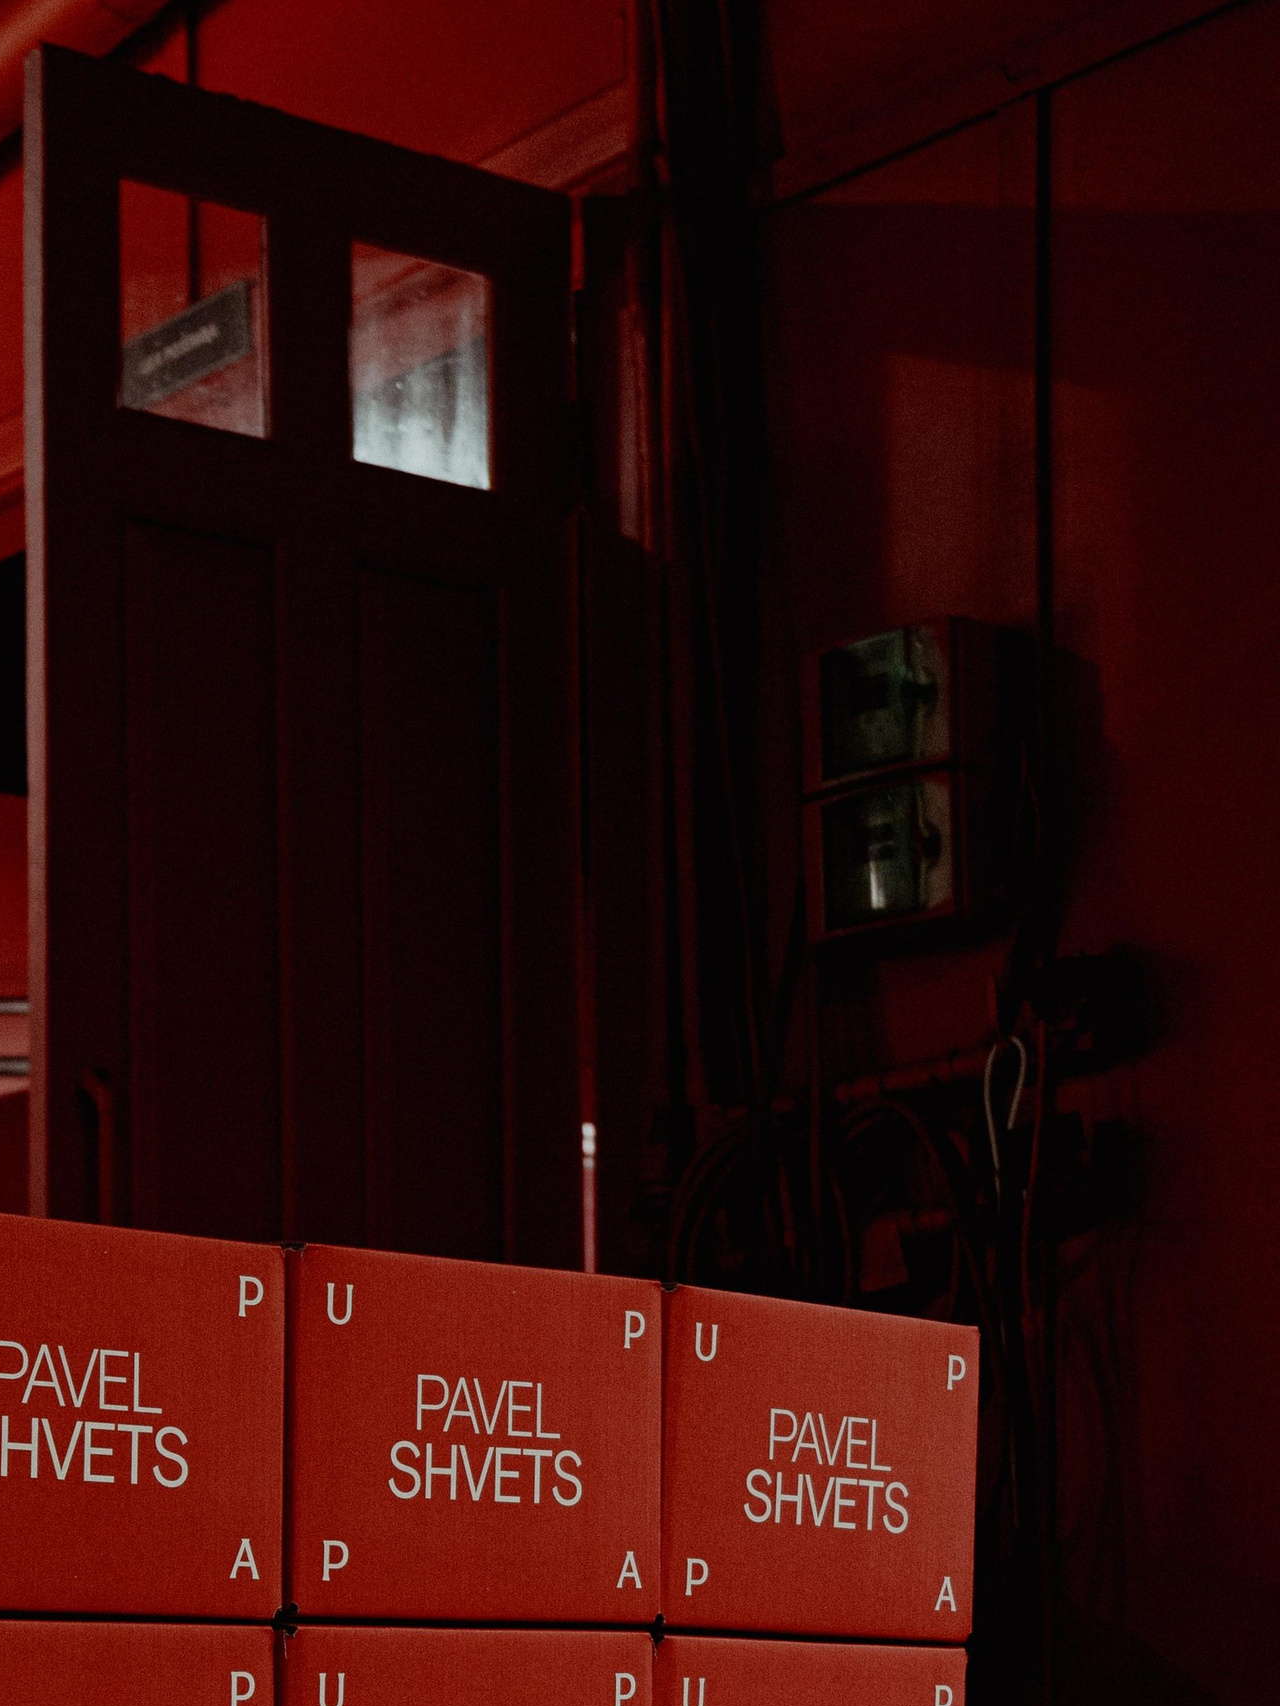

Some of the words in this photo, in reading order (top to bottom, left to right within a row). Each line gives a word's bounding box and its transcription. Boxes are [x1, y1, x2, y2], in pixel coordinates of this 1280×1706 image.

[238, 1274, 264, 1318] P
[326, 1282, 354, 1326] U
[623, 1309, 646, 1350] P
[695, 1321, 719, 1362] U
[946, 1354, 969, 1392] P
[416, 1373, 561, 1440] PAVEL
[768, 1407, 893, 1472] PAVEL
[387, 1440, 583, 1507] SHVETS
[743, 1468, 910, 1535] SHVETS
[229, 1537, 260, 1580] A
[321, 1539, 350, 1582] P
[616, 1550, 643, 1589] A
[684, 1557, 709, 1597] P
[934, 1575, 958, 1613] A
